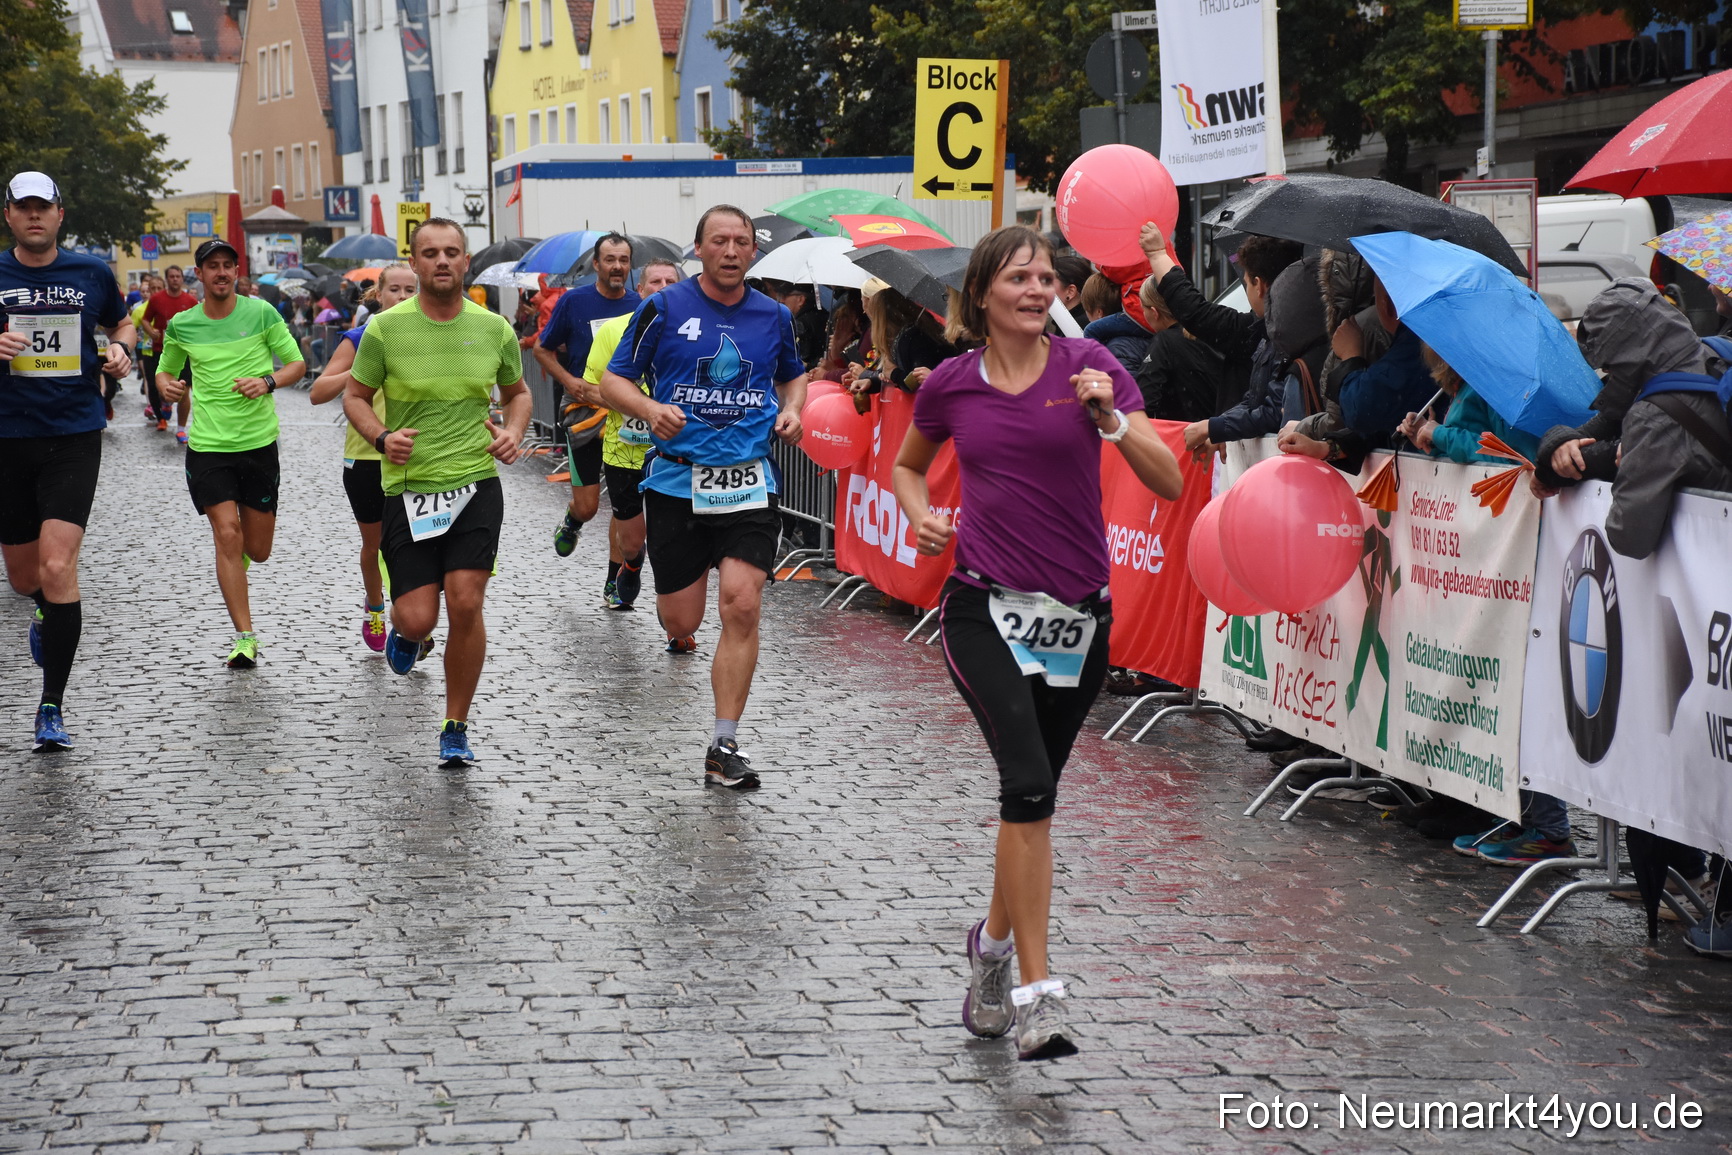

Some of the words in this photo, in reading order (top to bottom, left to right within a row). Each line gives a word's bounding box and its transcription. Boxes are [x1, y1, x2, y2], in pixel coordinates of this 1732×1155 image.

[1125, 15, 1149, 26] Ulmer
[533, 76, 556, 101] HOTEL
[927, 64, 997, 91] Block
[937, 101, 984, 171] C
[400, 204, 426, 214] Block
[47, 286, 86, 299] HiRo
[32, 330, 61, 353] 54
[678, 317, 702, 341] 4
[35, 359, 58, 369] Sven
[672, 386, 764, 407] FIBALON
[700, 407, 740, 416] BASKETS
[700, 465, 758, 490] 2495
[708, 493, 751, 505] Christian
[1411, 490, 1457, 522] Service-Line:
[1563, 534, 1616, 613] BMW
[1003, 612, 1088, 649] 2435
[1406, 632, 1500, 693] Gebäudereinigung
[1405, 681, 1499, 735] Hausmeisterdienst
[1405, 730, 1504, 792] Arbeitsbühnenverleih
